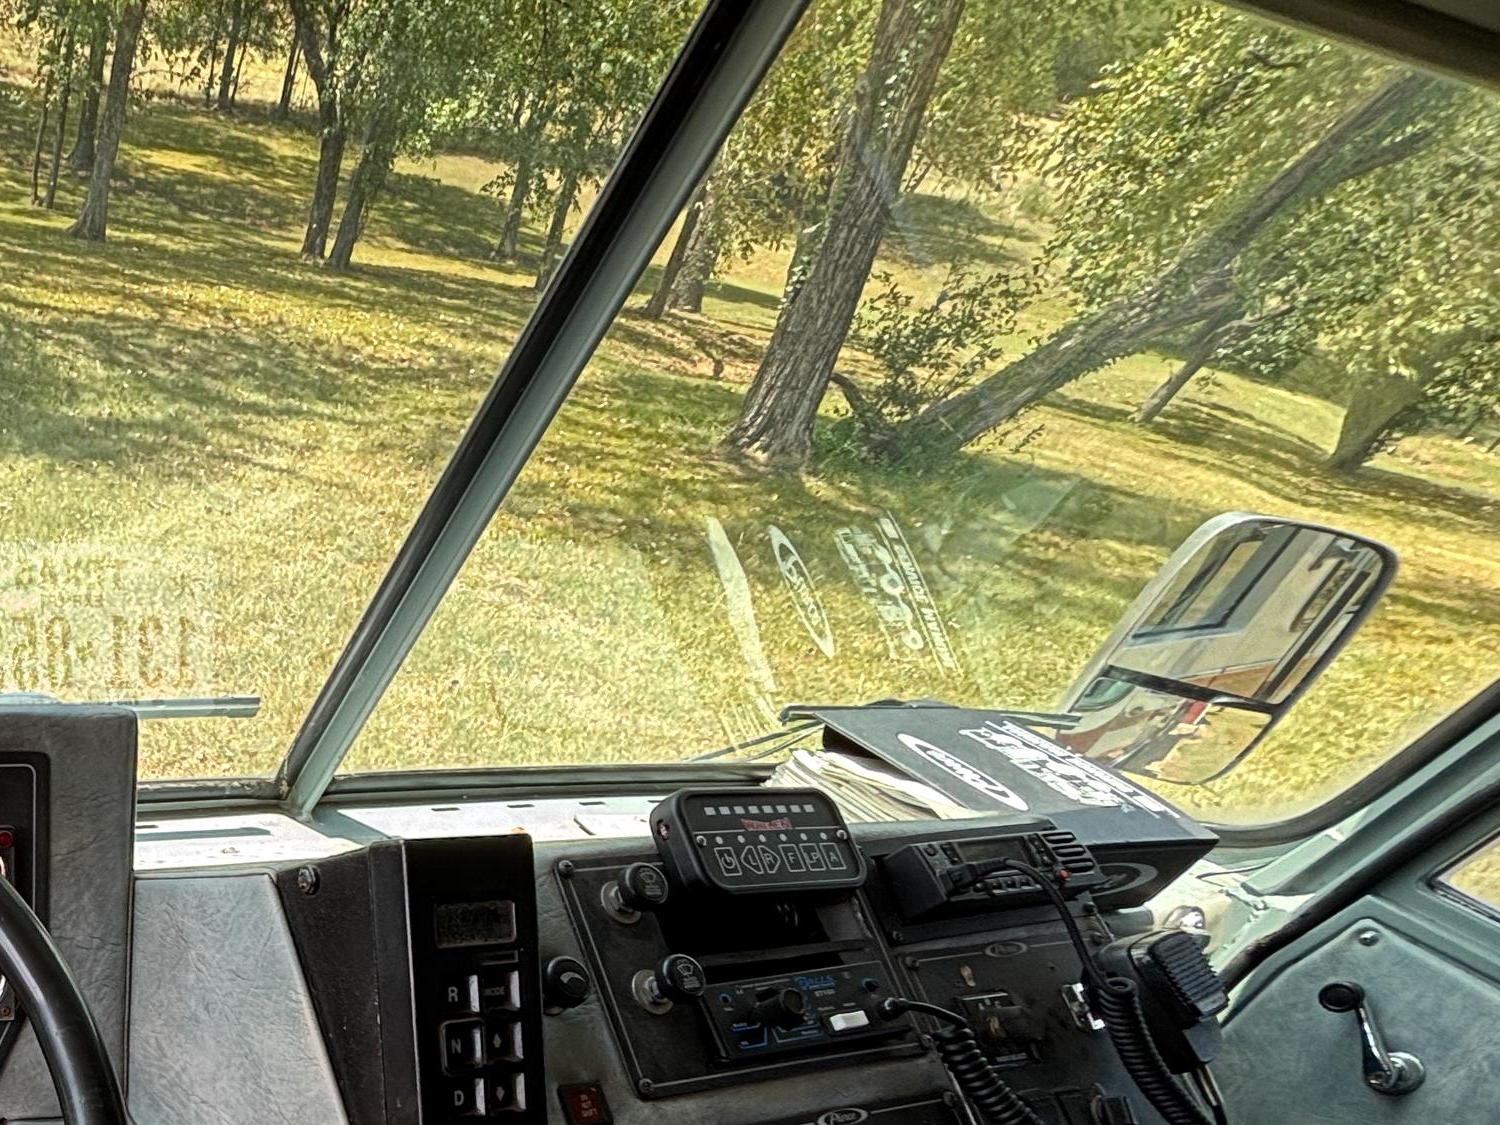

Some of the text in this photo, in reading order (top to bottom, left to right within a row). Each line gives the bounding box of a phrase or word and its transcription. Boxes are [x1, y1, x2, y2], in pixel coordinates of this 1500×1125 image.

[765, 853, 775, 864] R
[787, 853, 797, 863] F
[831, 852, 839, 862] A
[448, 986, 459, 1002] R
[451, 1038, 462, 1054] N
[454, 1090, 465, 1106] D
